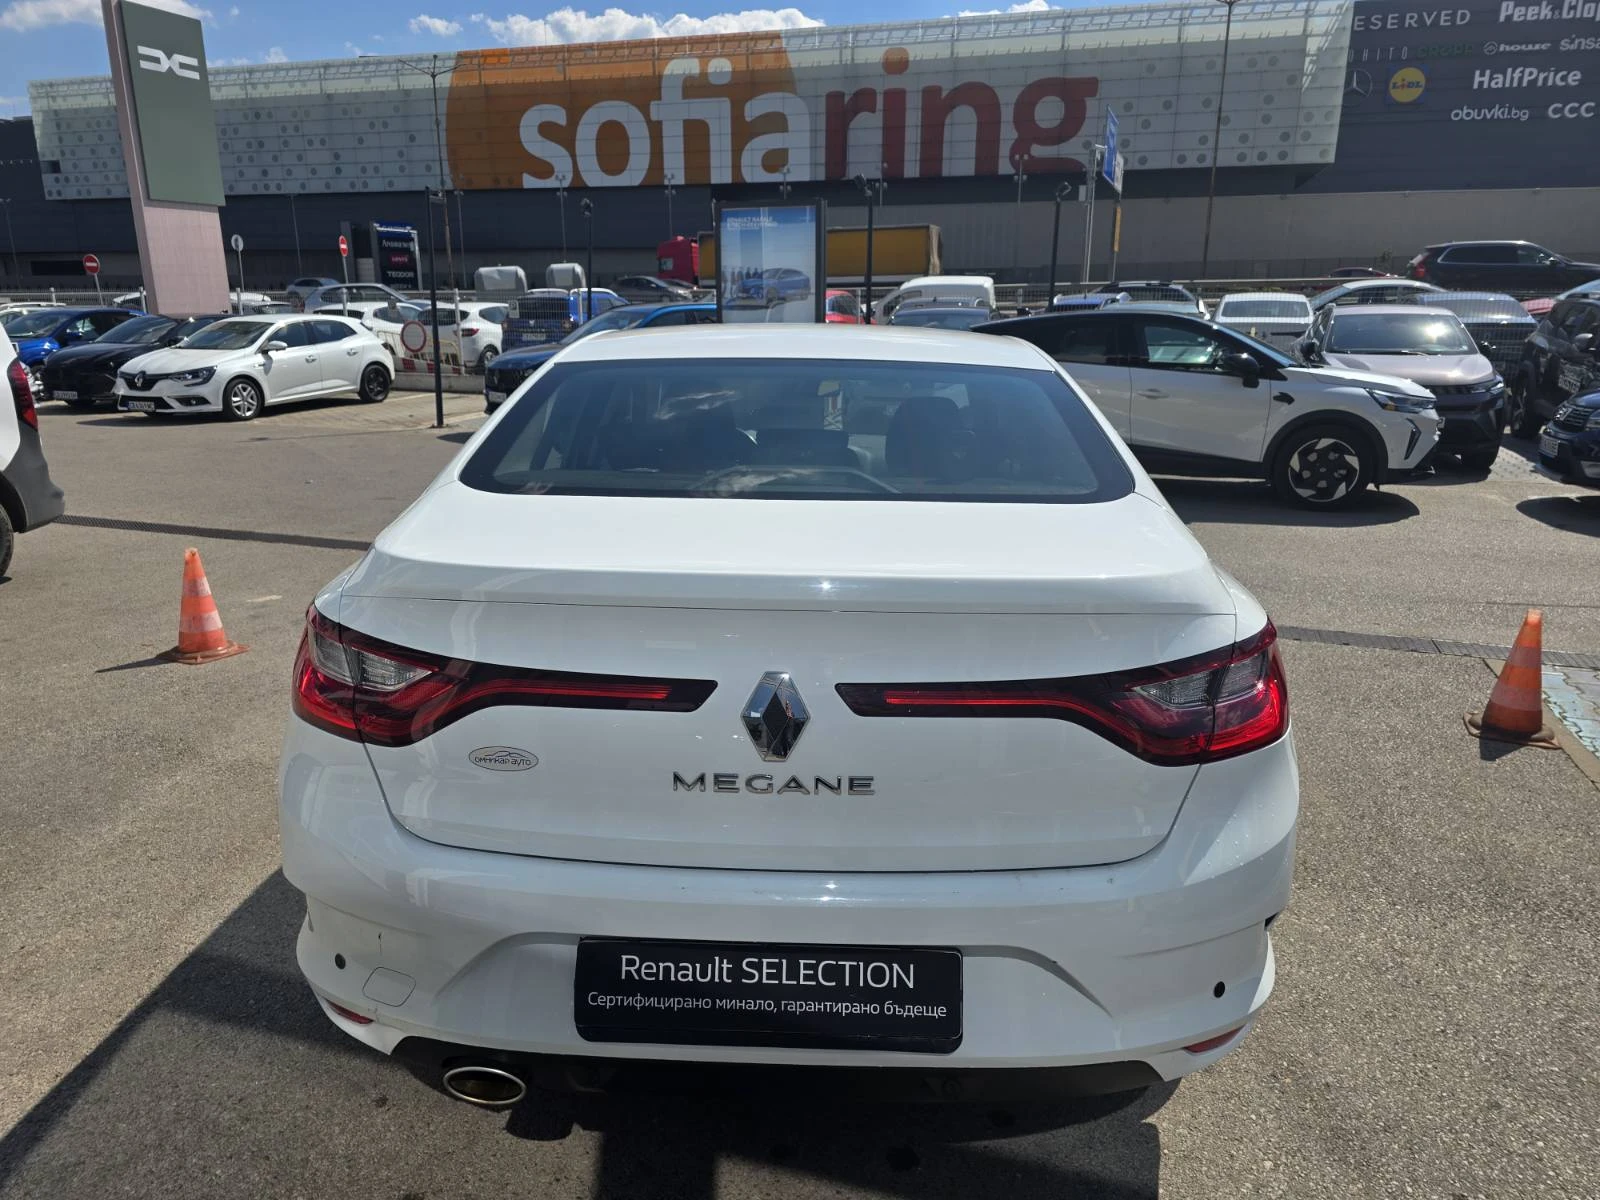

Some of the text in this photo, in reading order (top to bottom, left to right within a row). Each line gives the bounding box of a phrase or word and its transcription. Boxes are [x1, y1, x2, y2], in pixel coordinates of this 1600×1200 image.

[1473, 67, 1582, 90] HalfPrice
[1450, 104, 1529, 121] obuvki.bg
[1547, 102, 1595, 119] CCC
[672, 771, 876, 796] MEGANE
[620, 954, 915, 990] Renault SELECTION
[587, 991, 947, 1019] Сертифицирано минало, гарантирано бъдеще
